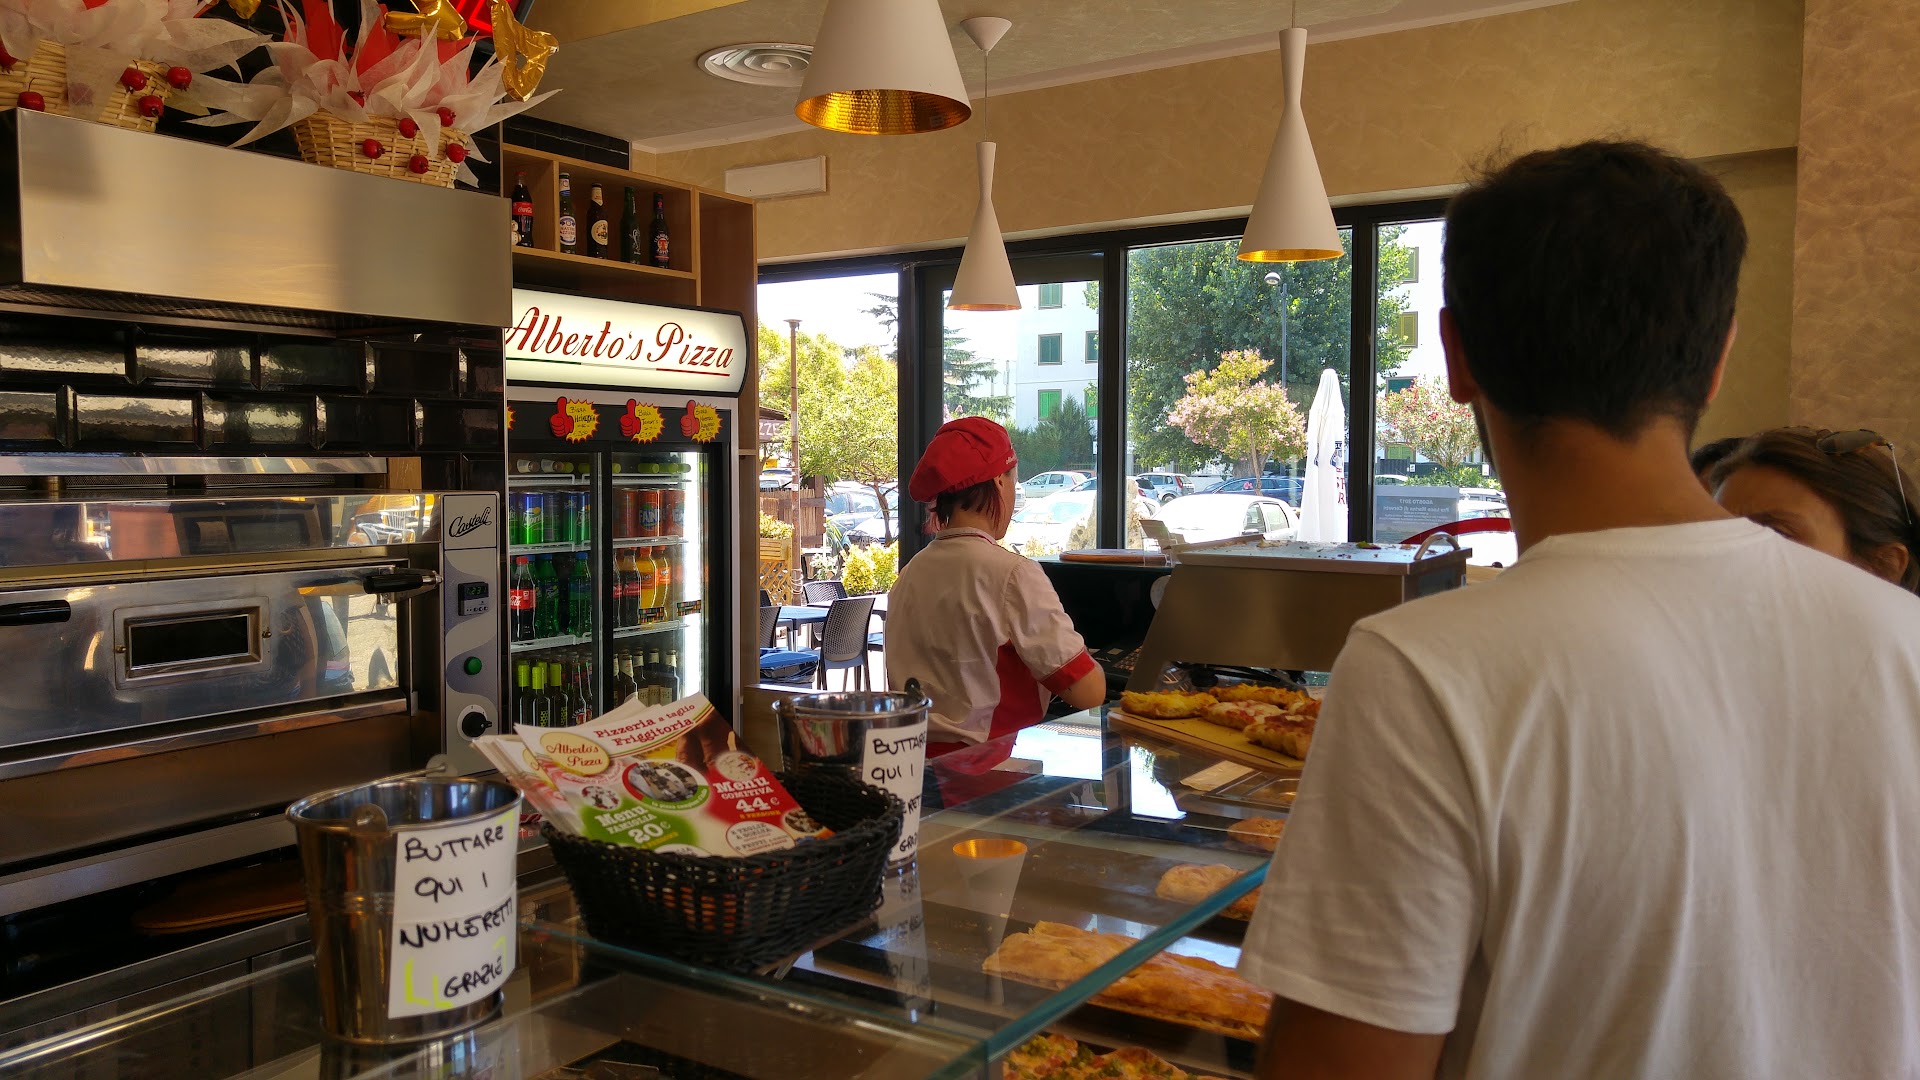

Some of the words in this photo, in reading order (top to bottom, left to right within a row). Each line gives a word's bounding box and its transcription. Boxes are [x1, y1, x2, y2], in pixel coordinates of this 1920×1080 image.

[505, 306, 643, 361] Alberto's
[646, 321, 734, 369] Pizza
[593, 717, 655, 738] Pizzeria
[666, 704, 695, 718] taglio
[612, 717, 694, 746] Friggitoria
[546, 742, 599, 754] Alberto's
[567, 755, 603, 767] Pizza
[713, 776, 770, 794] Menu
[871, 765, 902, 784] QUI
[721, 786, 774, 800] COMITIVA
[736, 797, 771, 813] 44
[594, 806, 649, 827] Menu
[606, 813, 657, 834] FAMIGLIA
[405, 825, 504, 862] BUTTARE
[628, 823, 664, 844] 20
[414, 875, 464, 903] QUI
[482, 872, 488, 888] I
[400, 896, 514, 949] NUMERETTI
[443, 956, 504, 998] GRAZIE
